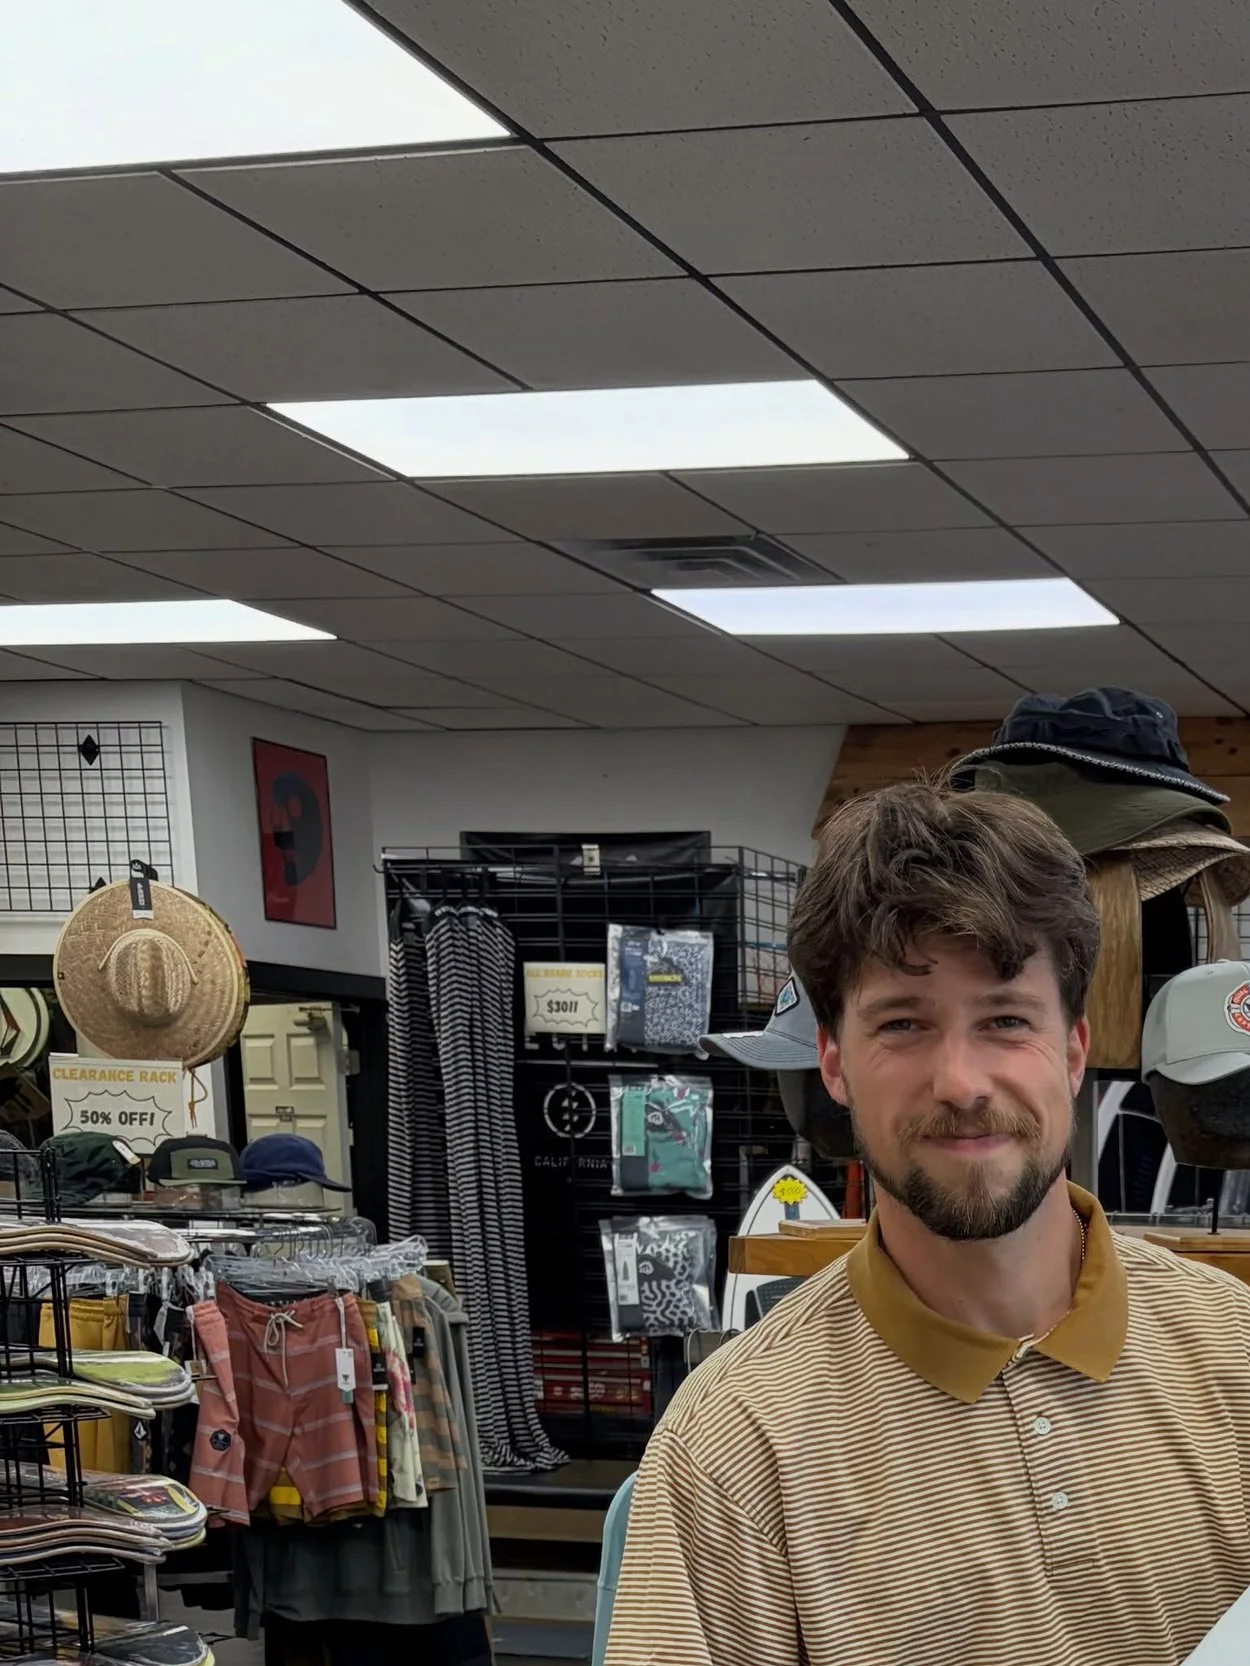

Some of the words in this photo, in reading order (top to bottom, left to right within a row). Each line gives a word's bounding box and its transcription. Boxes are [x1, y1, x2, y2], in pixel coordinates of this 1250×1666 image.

[52, 1067, 135, 1082] CLEARANCE
[139, 1070, 177, 1083] RACK
[80, 1110, 112, 1125] 50%
[534, 1155, 608, 1169] CALIFRNIA
